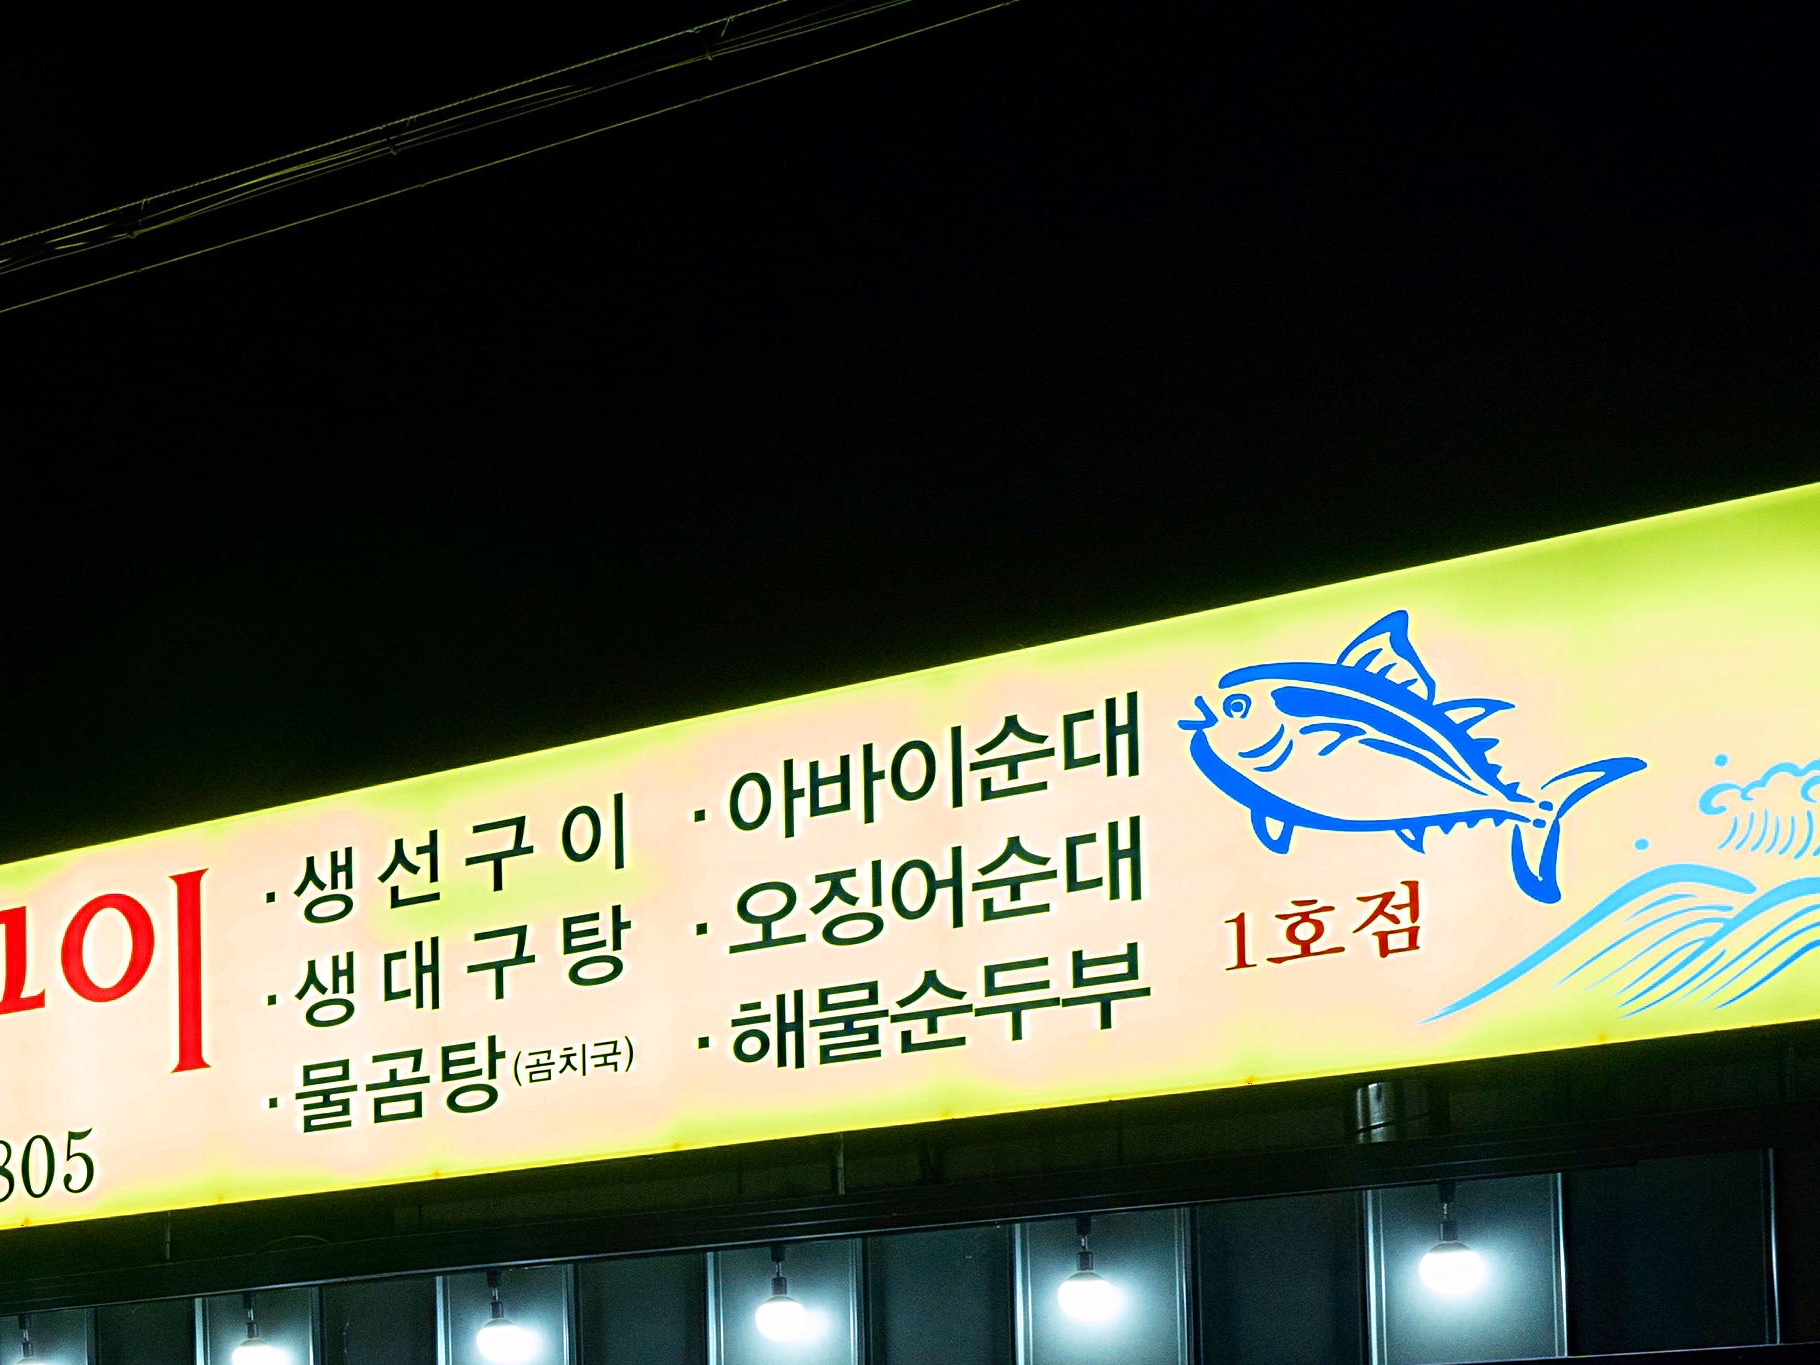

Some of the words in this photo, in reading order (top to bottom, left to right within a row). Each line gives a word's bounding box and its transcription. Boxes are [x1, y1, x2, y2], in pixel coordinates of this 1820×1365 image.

[729, 691, 1141, 838] 아바이순대
[293, 792, 625, 924] 생선구이
[729, 815, 1143, 954] 오징어순대
[294, 905, 632, 1028] 생대구탕
[1224, 880, 1422, 971] 1호점
[730, 941, 1151, 1070] 해물순두부
